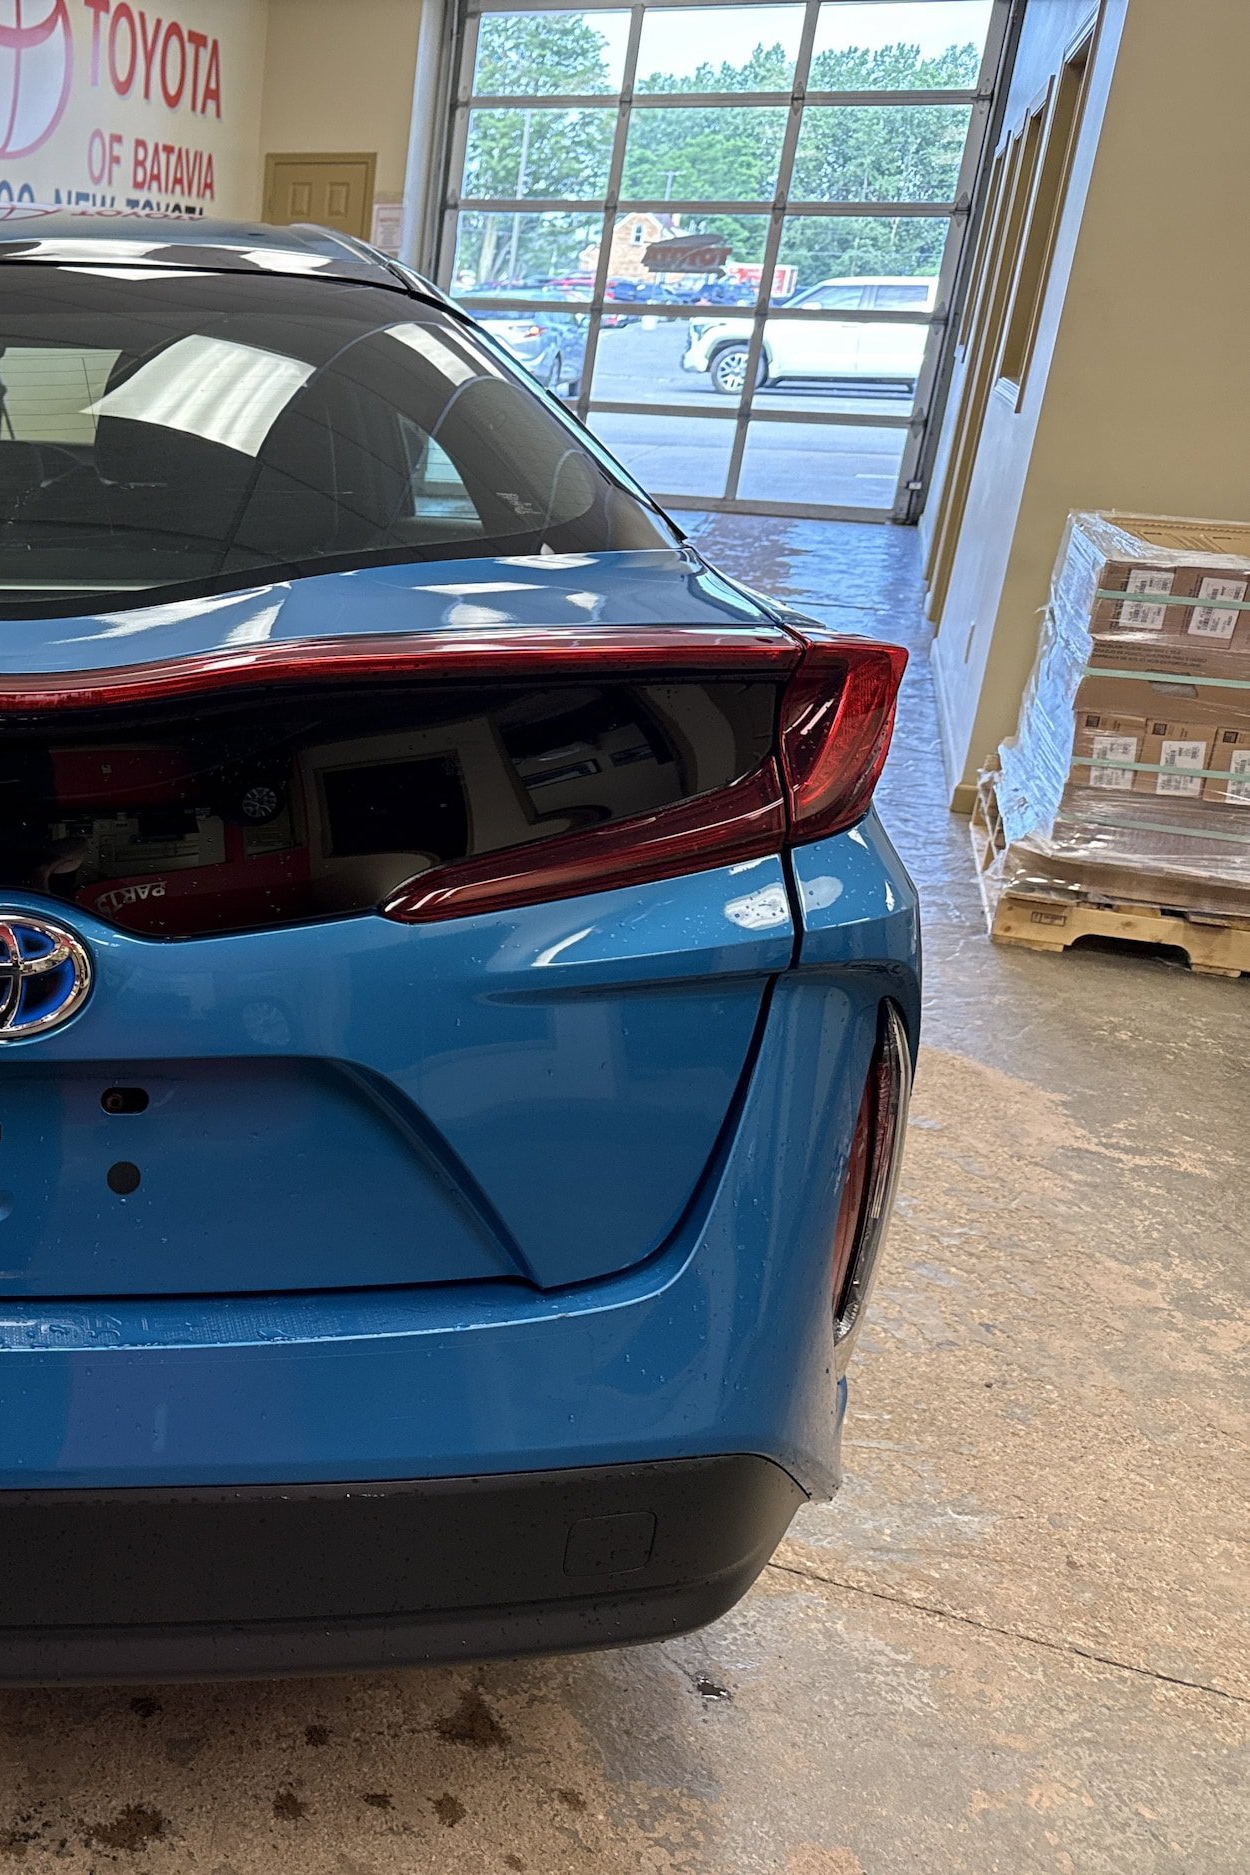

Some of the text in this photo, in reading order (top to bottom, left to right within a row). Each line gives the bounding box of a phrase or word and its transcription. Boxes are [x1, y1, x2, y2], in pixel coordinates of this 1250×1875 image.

[84, 0, 221, 119] TOYOTA
[87, 127, 215, 201] OF BATAVIA
